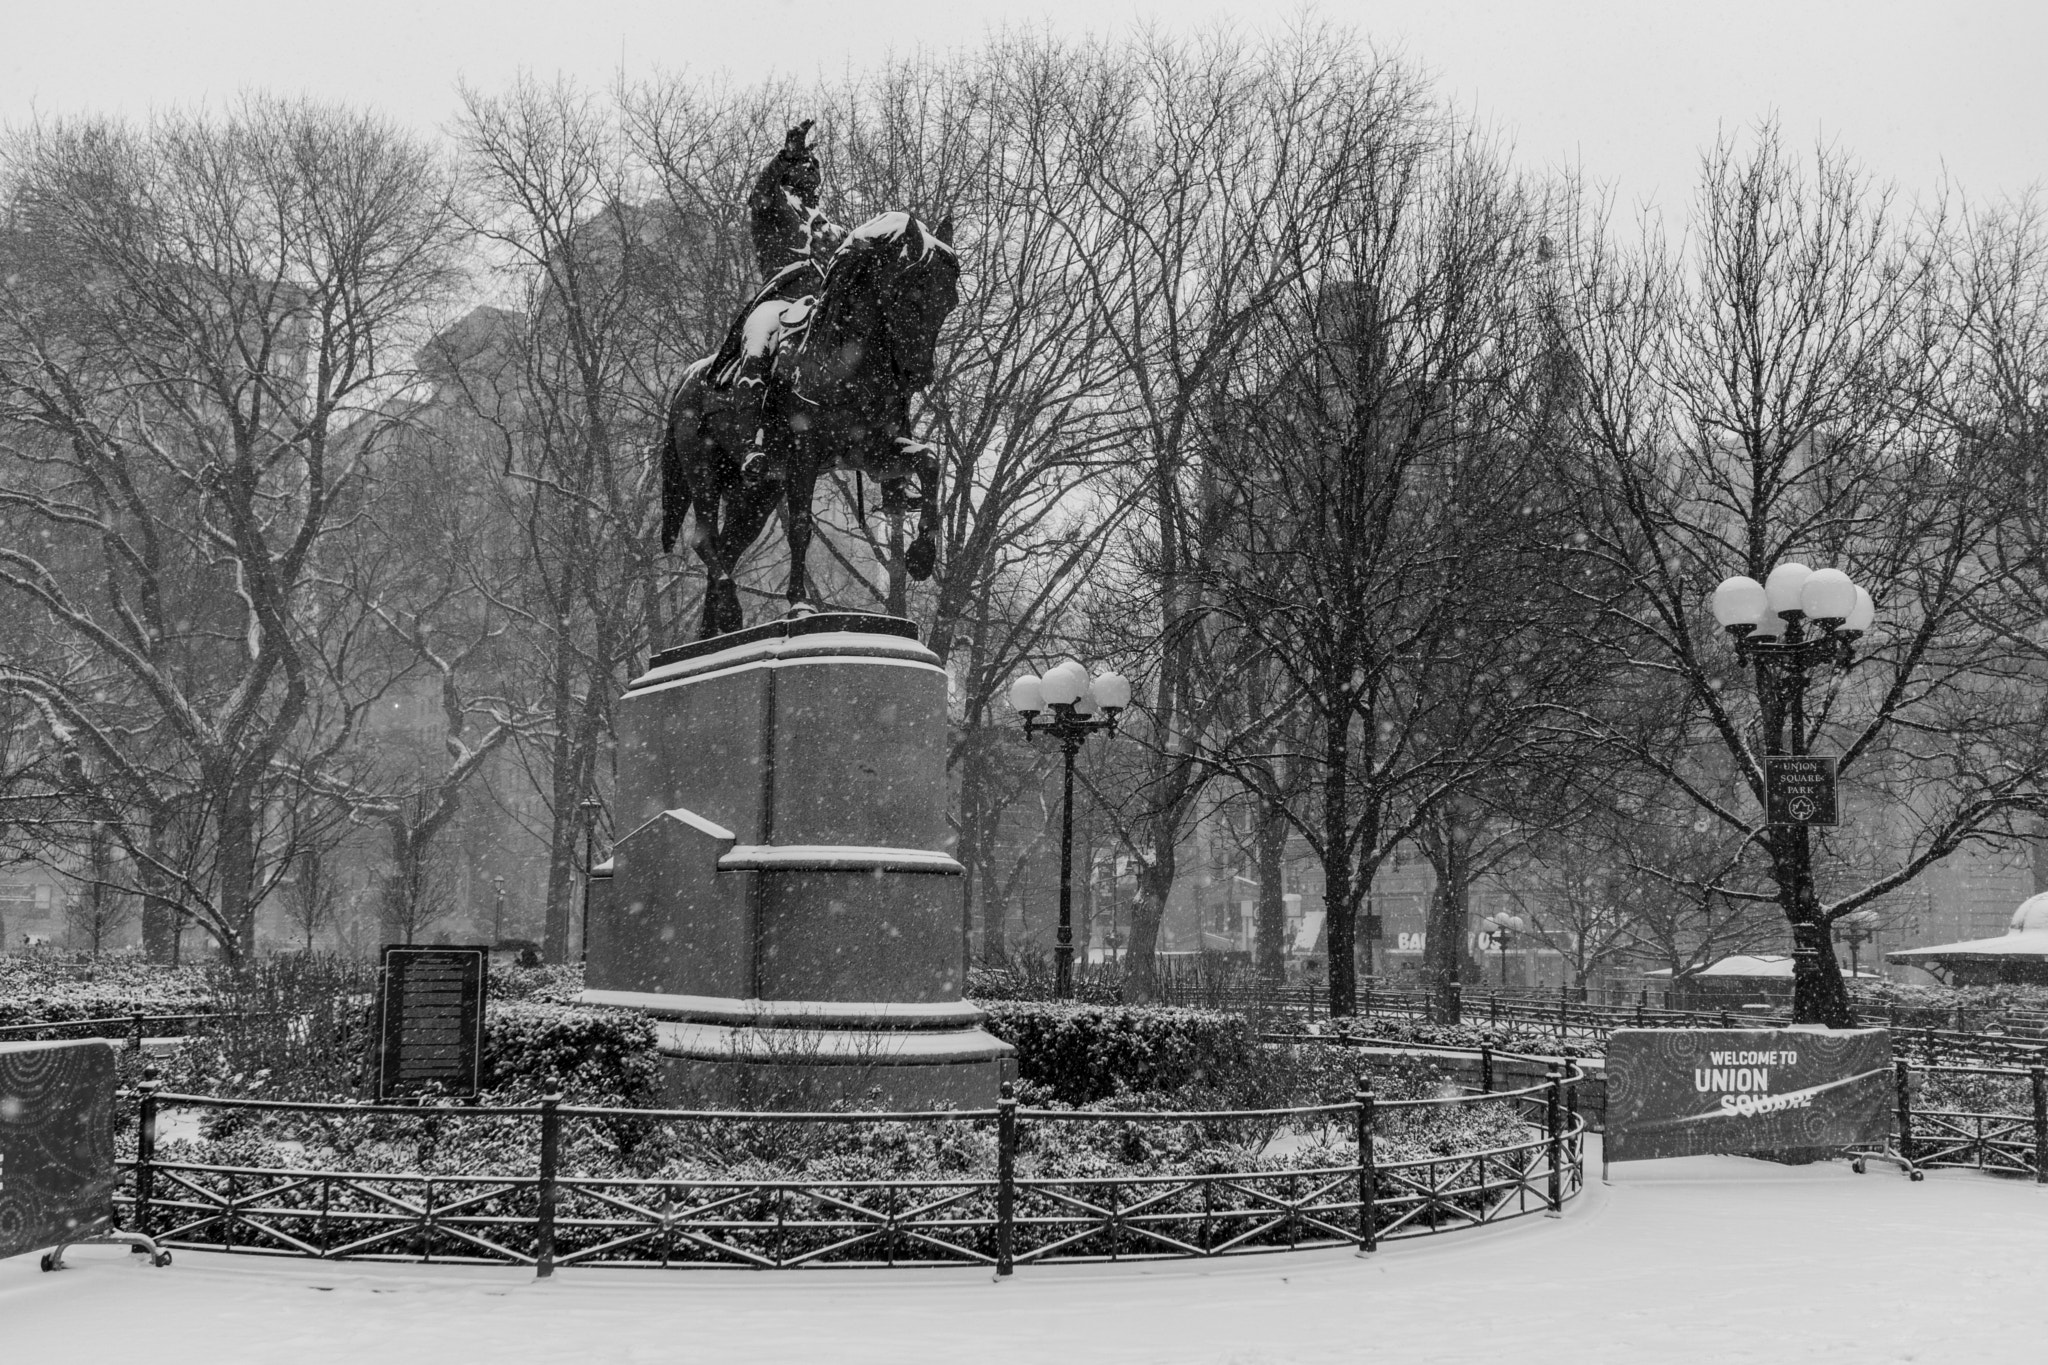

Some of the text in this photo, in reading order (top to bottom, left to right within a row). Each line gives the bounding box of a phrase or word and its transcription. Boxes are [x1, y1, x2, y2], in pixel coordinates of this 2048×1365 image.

[1783, 762, 1817, 771] UNION
[1780, 774, 1821, 783] SQUARE
[1787, 786, 1815, 794] PARK
[1710, 1051, 1798, 1066] WELCOME TO
[1695, 1068, 1768, 1092] UNION
